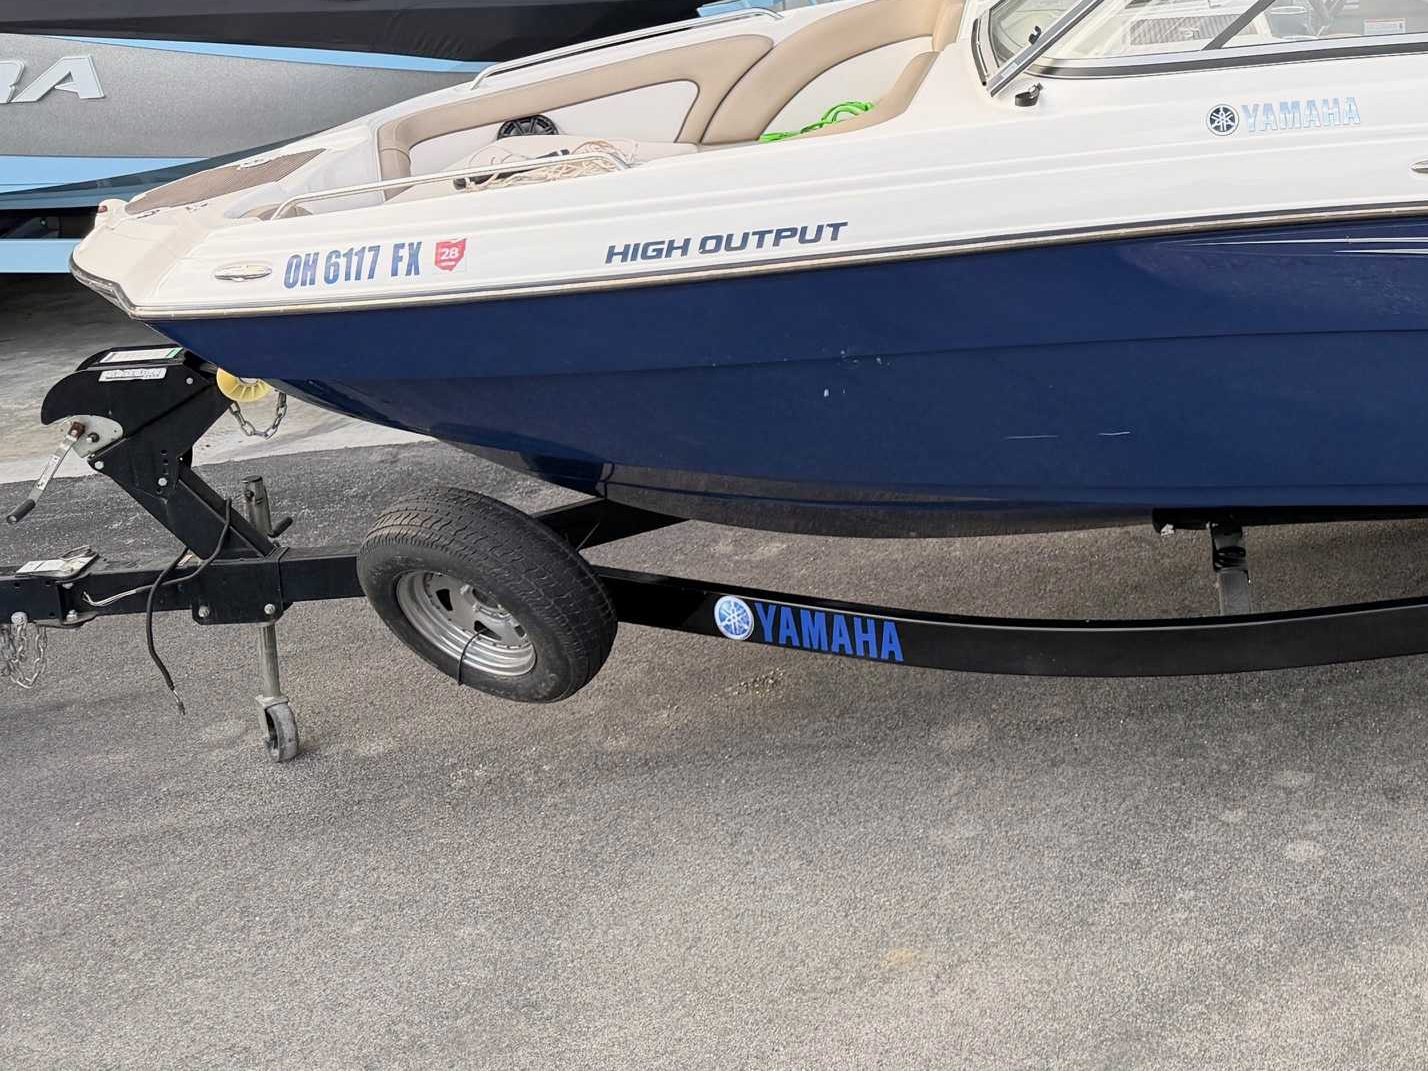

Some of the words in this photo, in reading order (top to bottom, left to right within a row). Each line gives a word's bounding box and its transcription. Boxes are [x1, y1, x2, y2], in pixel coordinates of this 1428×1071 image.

[1241, 96, 1360, 132] YAMAHA
[284, 252, 320, 289] OH
[324, 245, 381, 285] 6117
[391, 241, 423, 277] FX
[605, 237, 692, 264] HIGH
[698, 222, 848, 254] OUTPUT
[755, 602, 904, 662] YAMAHA
